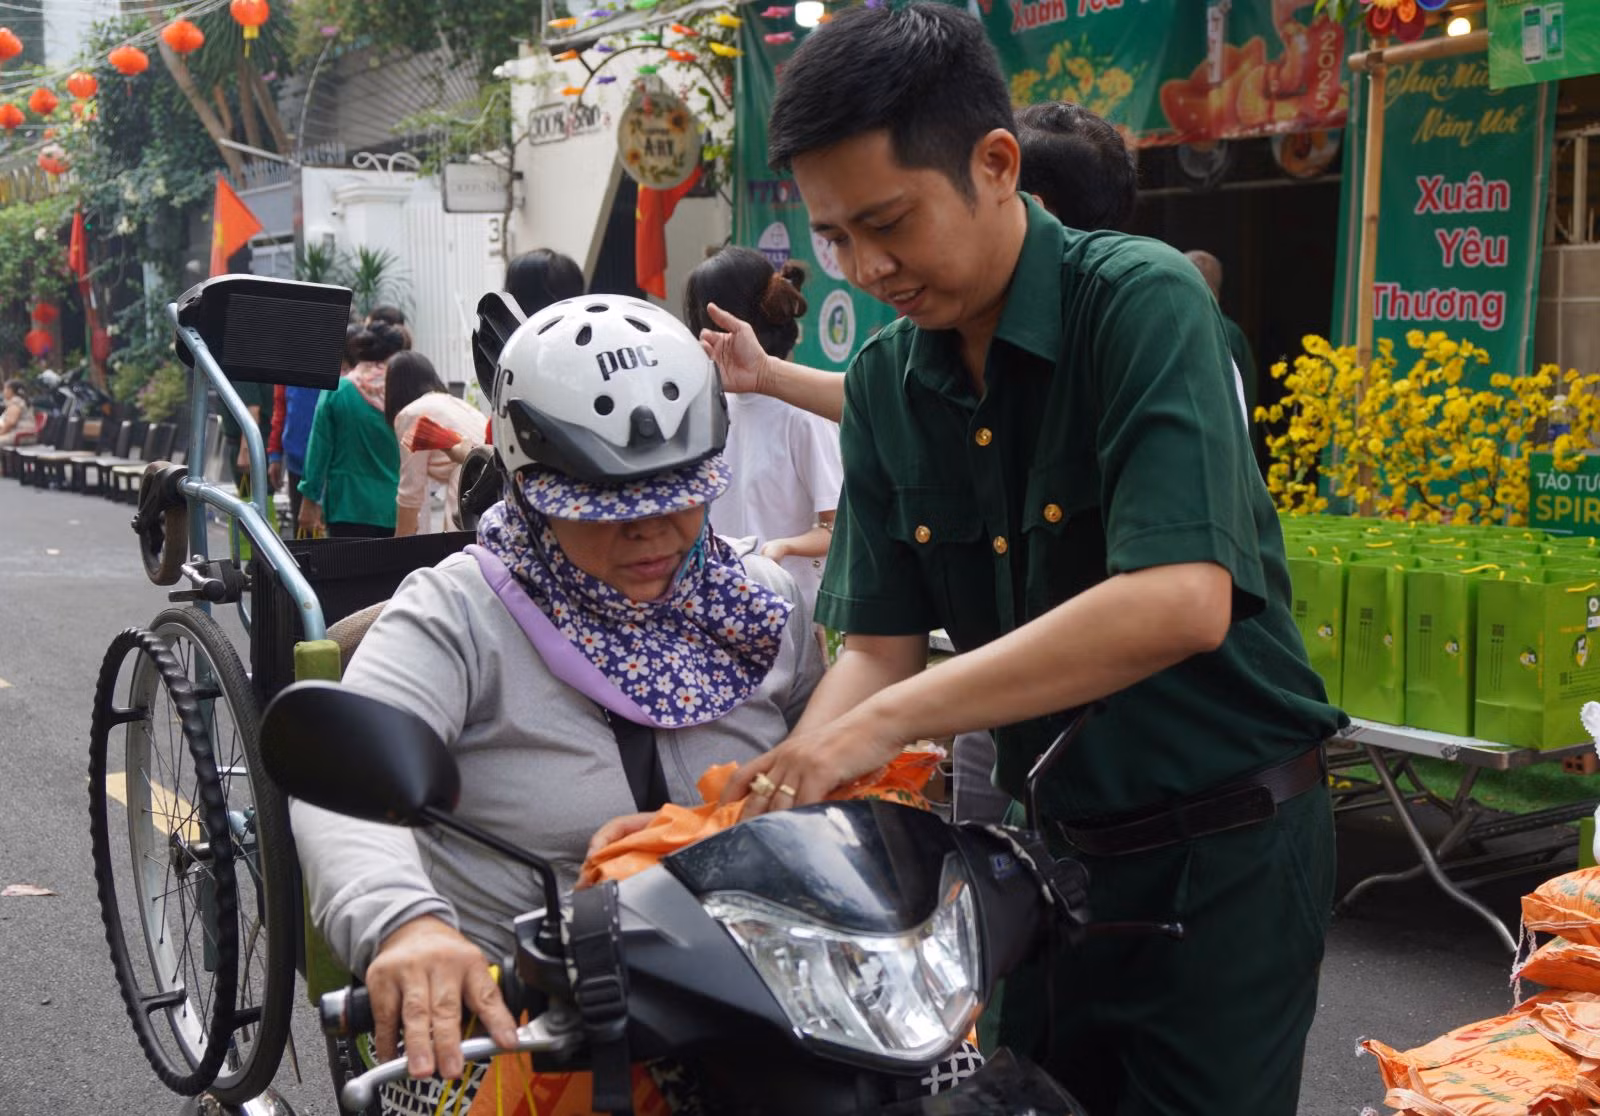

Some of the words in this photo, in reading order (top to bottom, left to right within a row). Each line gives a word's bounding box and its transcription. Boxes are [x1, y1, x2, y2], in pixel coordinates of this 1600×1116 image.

[1314, 31, 1337, 110] 2025
[1414, 172, 1510, 214] Xuân
[1435, 226, 1509, 267] Yêu
[1373, 281, 1506, 331] Thương
